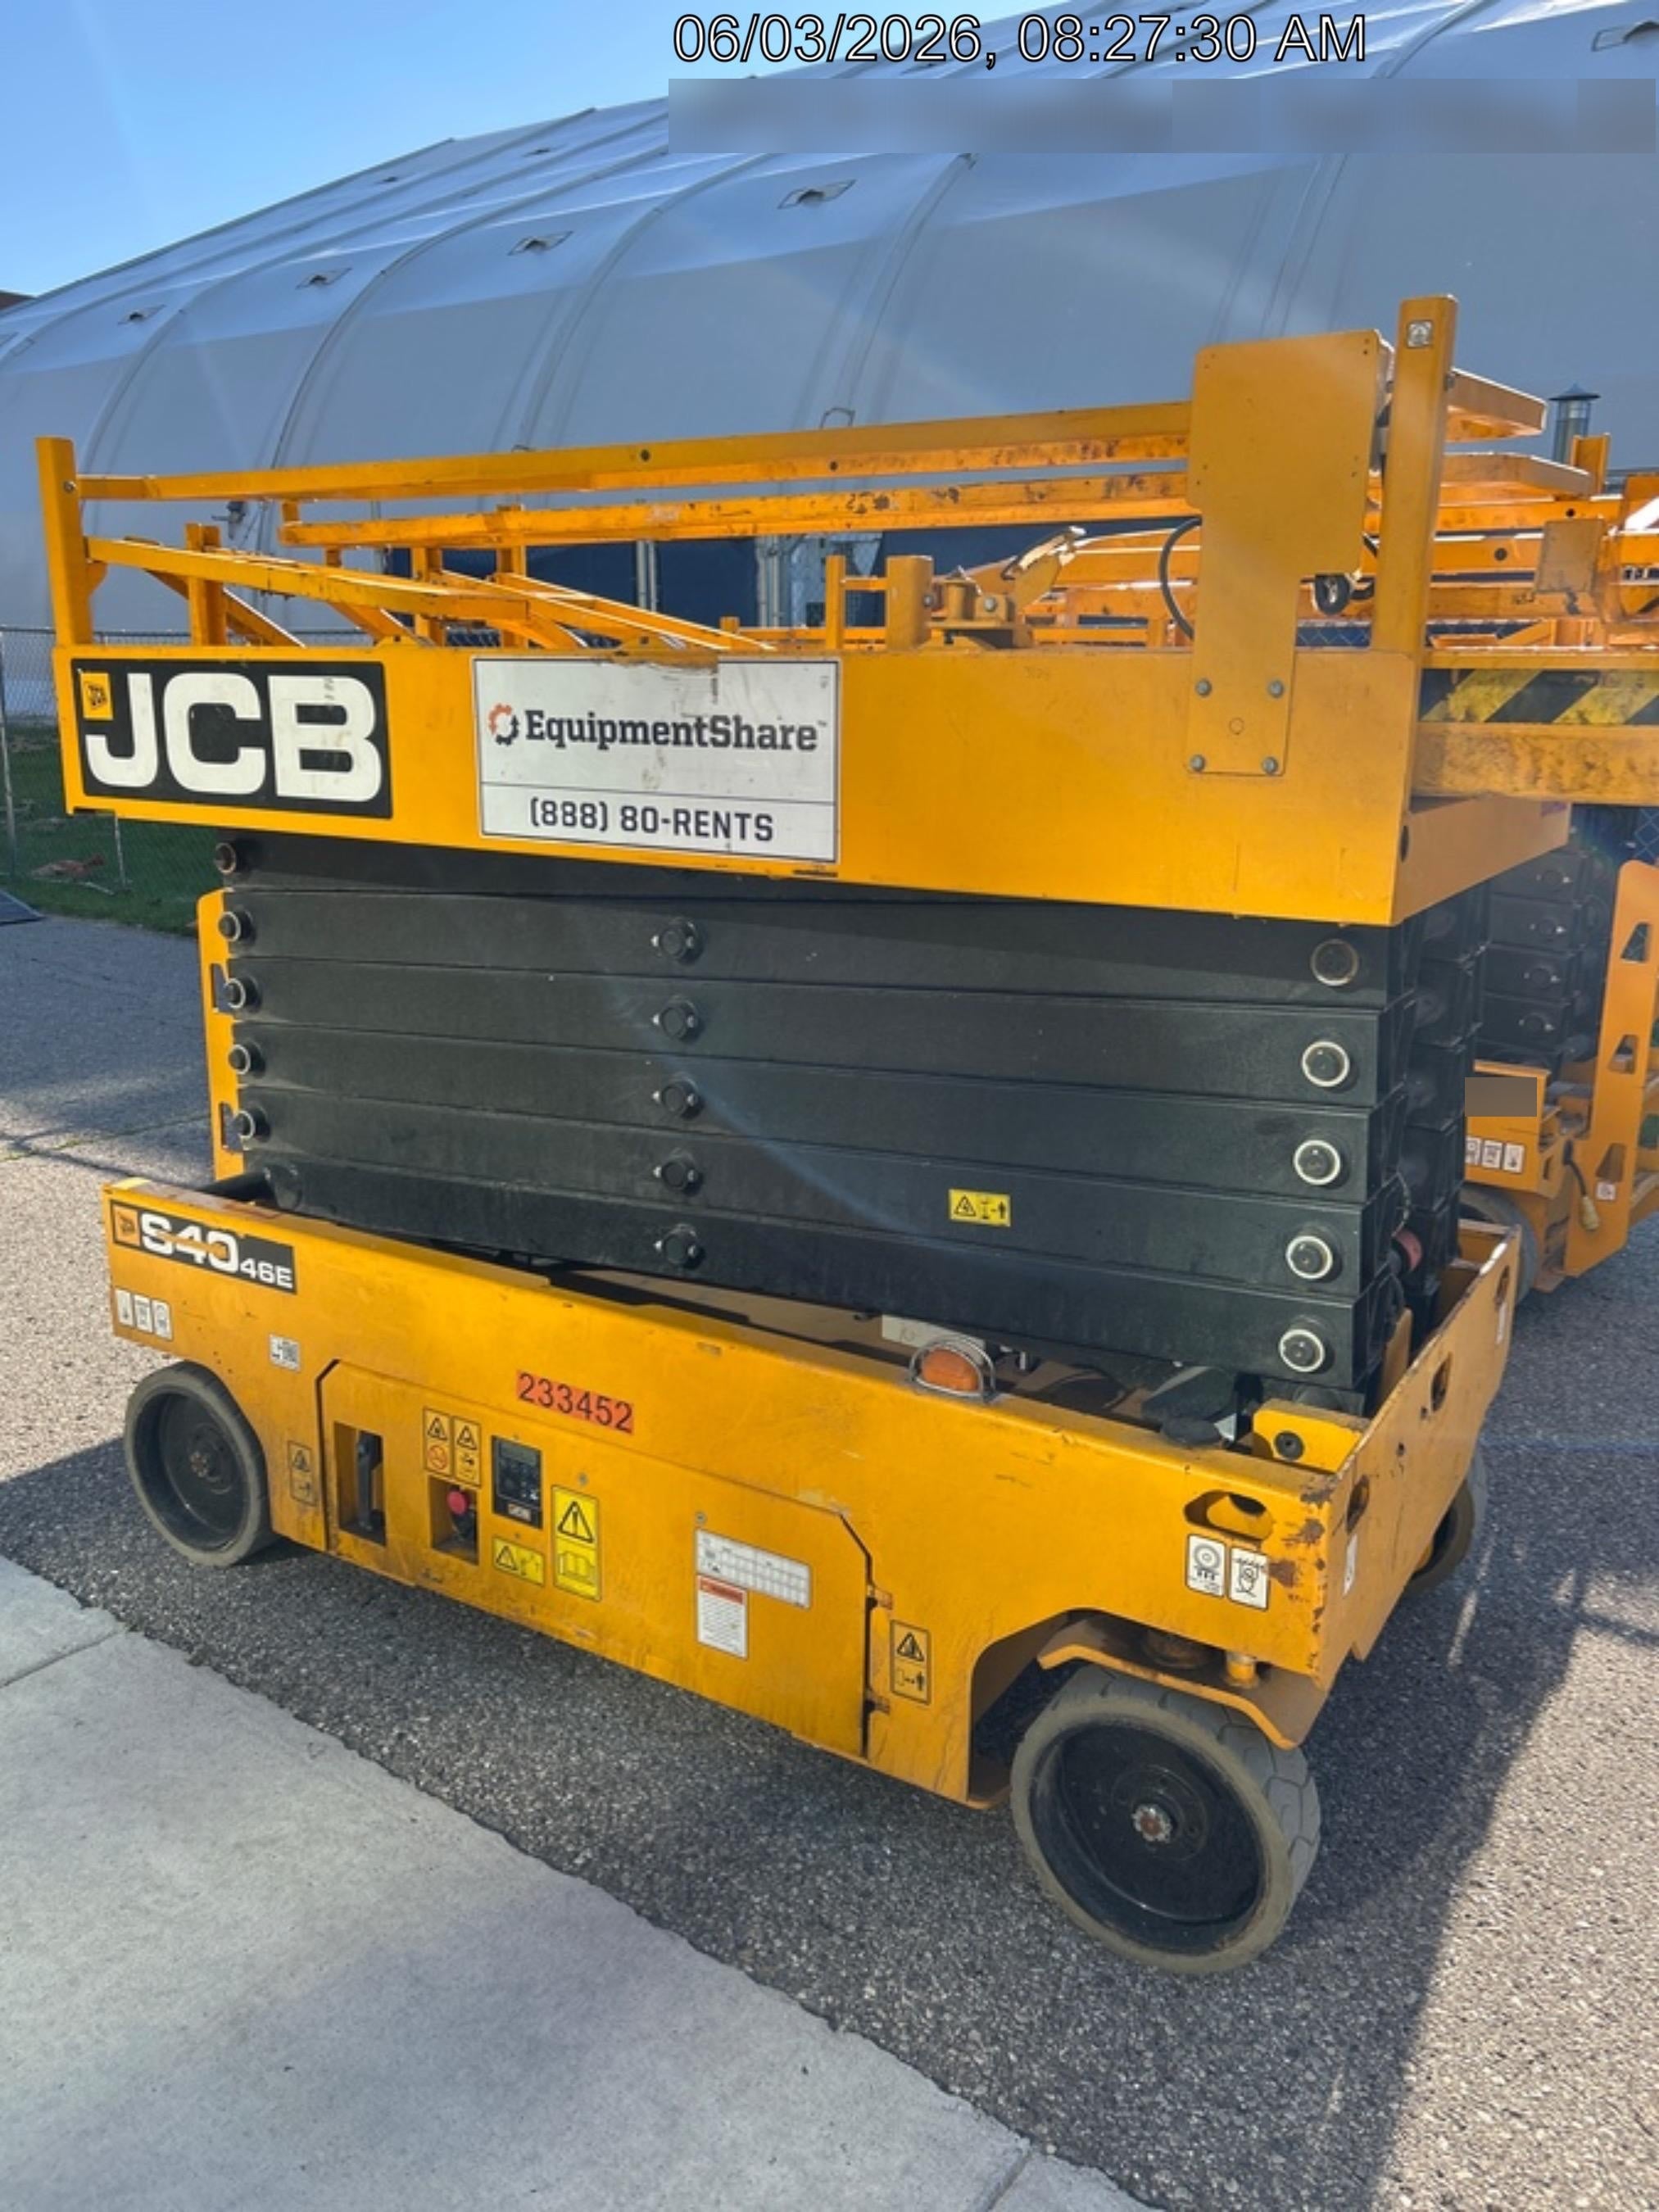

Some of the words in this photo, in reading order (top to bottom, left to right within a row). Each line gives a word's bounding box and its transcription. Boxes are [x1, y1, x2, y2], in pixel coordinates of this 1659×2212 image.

[84, 672, 383, 802] JCB
[524, 709, 818, 751] EquipmentShare
[530, 797, 609, 832] (888)
[620, 805, 773, 842] 80-RENTS
[519, 1373, 632, 1433] 233452
